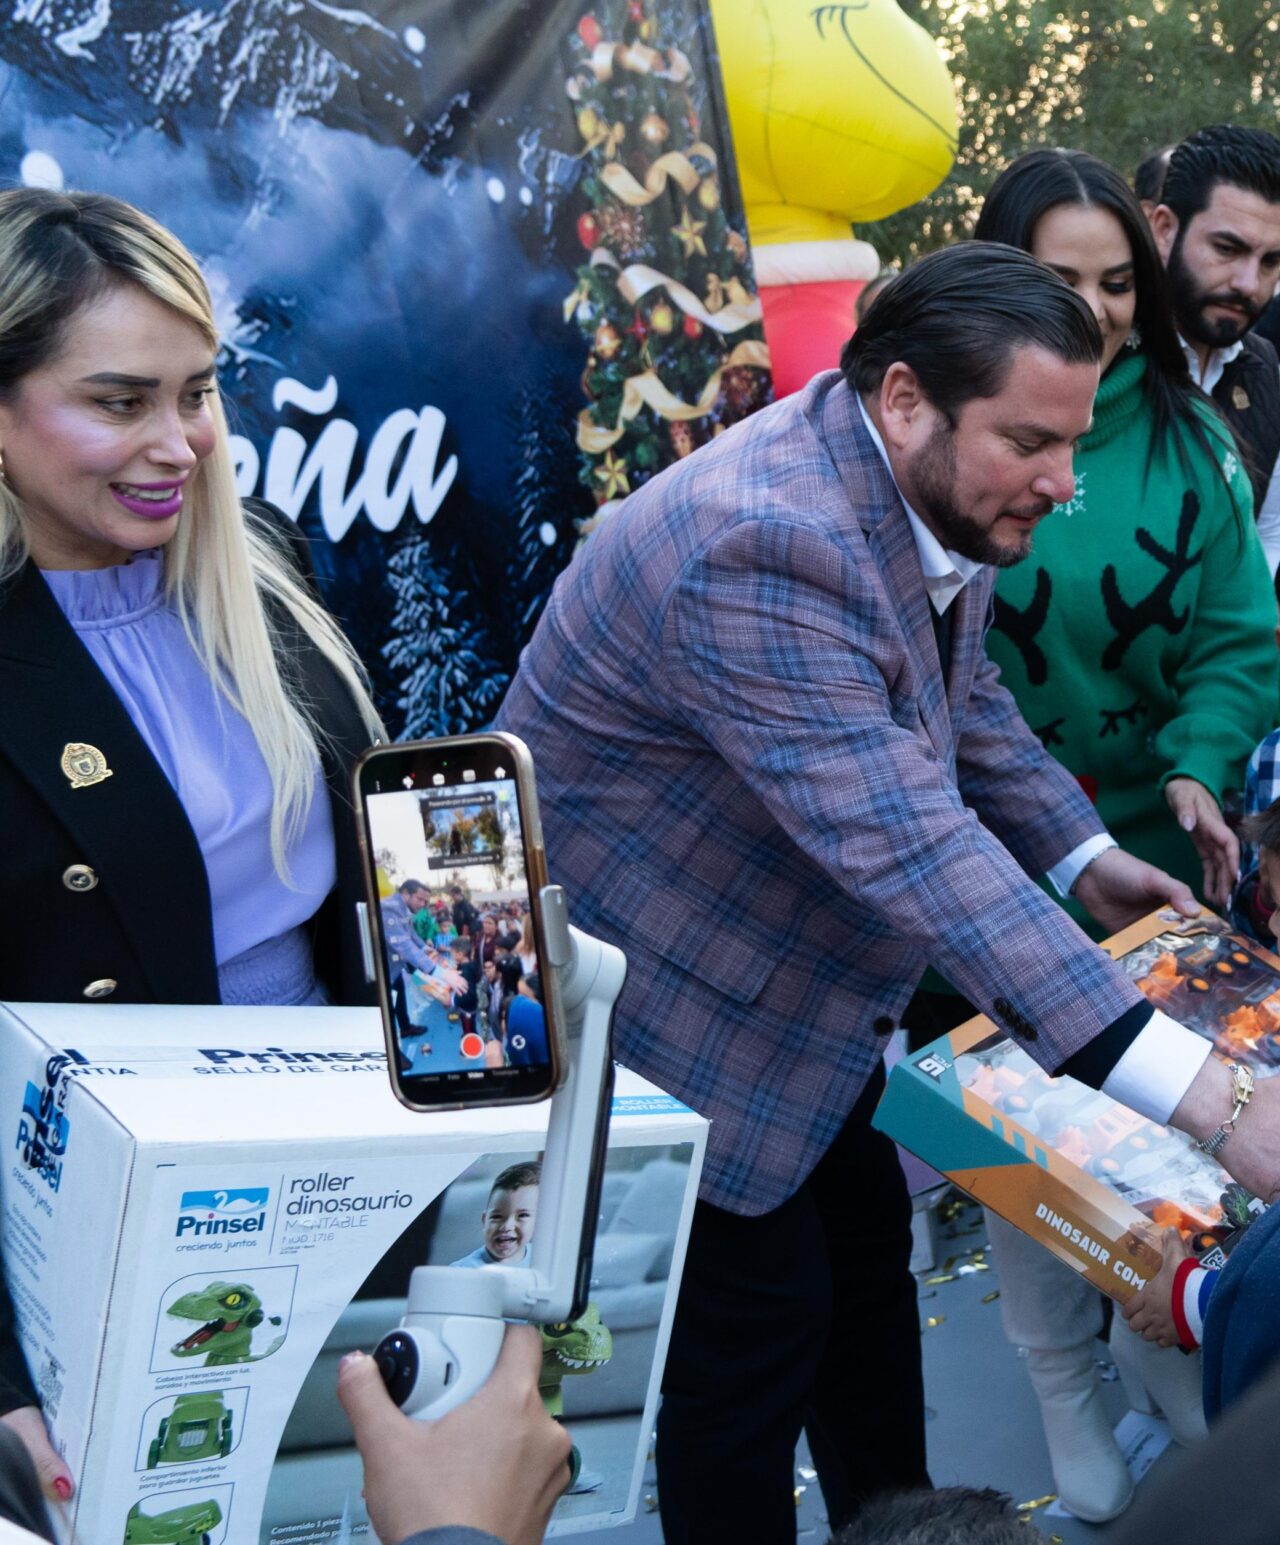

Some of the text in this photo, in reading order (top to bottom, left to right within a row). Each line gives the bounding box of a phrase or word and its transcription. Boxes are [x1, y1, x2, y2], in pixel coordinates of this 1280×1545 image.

[197, 1047, 388, 1064] Prinse
[193, 1066, 281, 1075] SELLO
[288, 1065, 324, 1073] DE
[289, 1172, 355, 1194] roller
[286, 1190, 413, 1216] dinosaurio
[176, 1212, 266, 1238] Prinsel
[176, 1239, 257, 1253] creciendo juntos
[1035, 1203, 1149, 1291] DINOSAUR COM
[271, 1522, 315, 1535] Contenido
